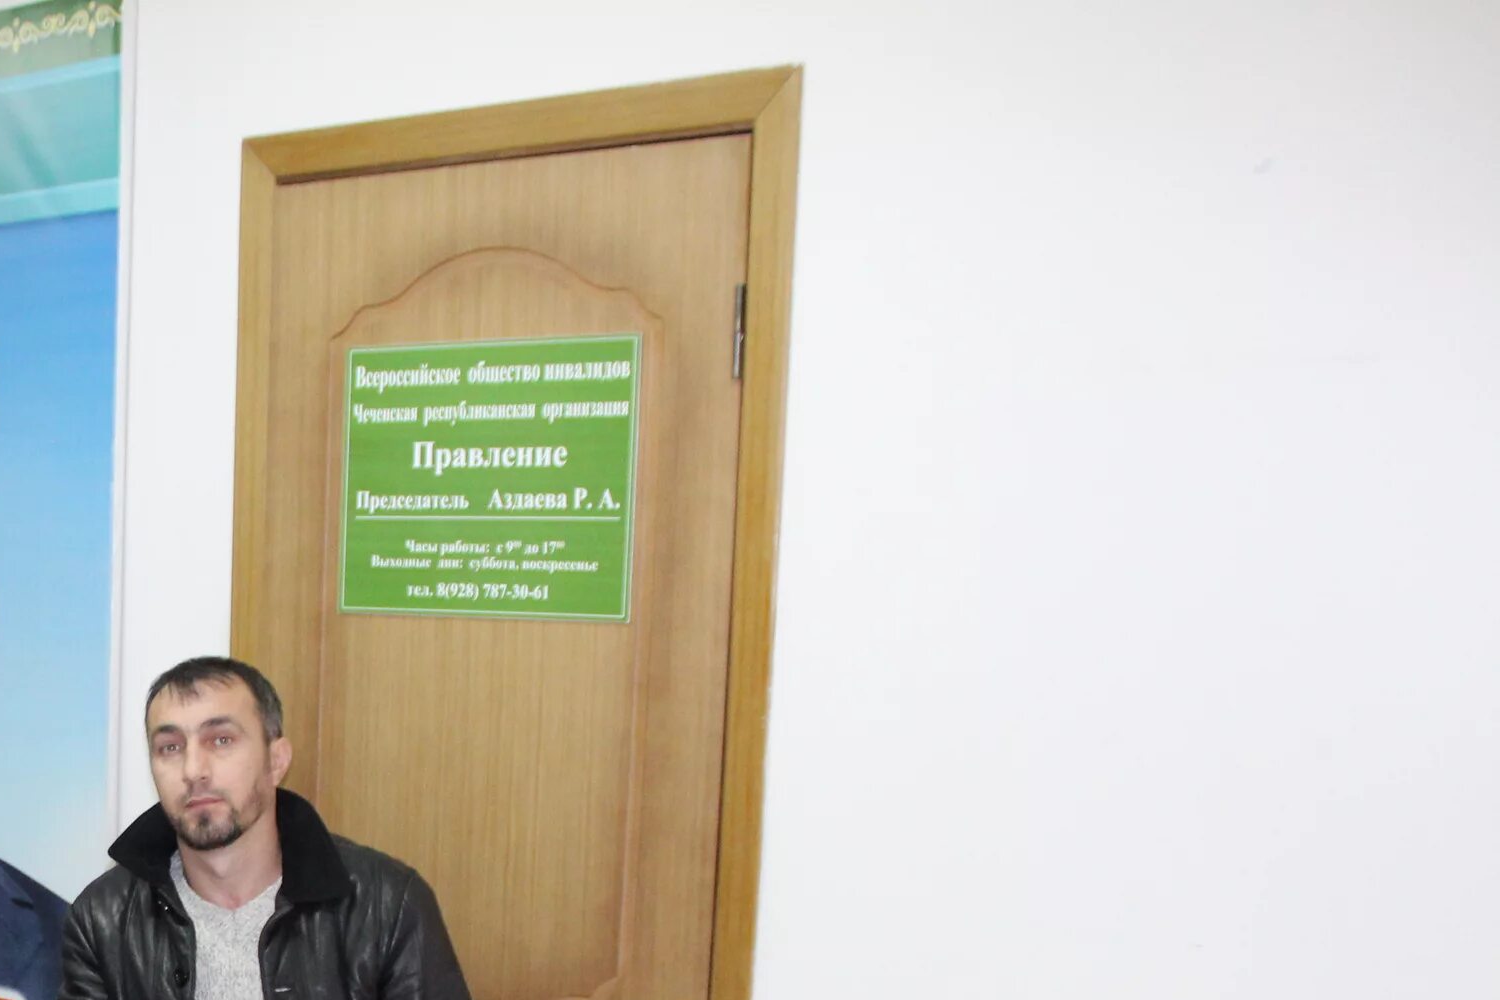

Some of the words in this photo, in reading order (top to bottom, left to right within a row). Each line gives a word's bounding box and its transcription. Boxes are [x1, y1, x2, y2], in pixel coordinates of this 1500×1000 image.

[355, 363, 461, 394] Всероссийское
[544, 360, 631, 382] инвалидов
[353, 402, 419, 424] Чеченская
[423, 400, 536, 427] республиканская
[541, 400, 630, 425] организация
[411, 440, 569, 476] Правление
[355, 490, 470, 514] Председатель
[487, 488, 568, 511] Аздаева
[573, 487, 593, 510] Р.
[598, 488, 621, 510] А.
[404, 539, 438, 553] Часы
[440, 539, 490, 556] работы:
[496, 543, 504, 553] с
[524, 543, 539, 556] до
[370, 554, 432, 568] Выходные
[437, 558, 464, 569] дни:
[407, 584, 434, 598] тел.
[436, 582, 479, 601] 8(928)
[482, 583, 549, 601] 787-30-61
